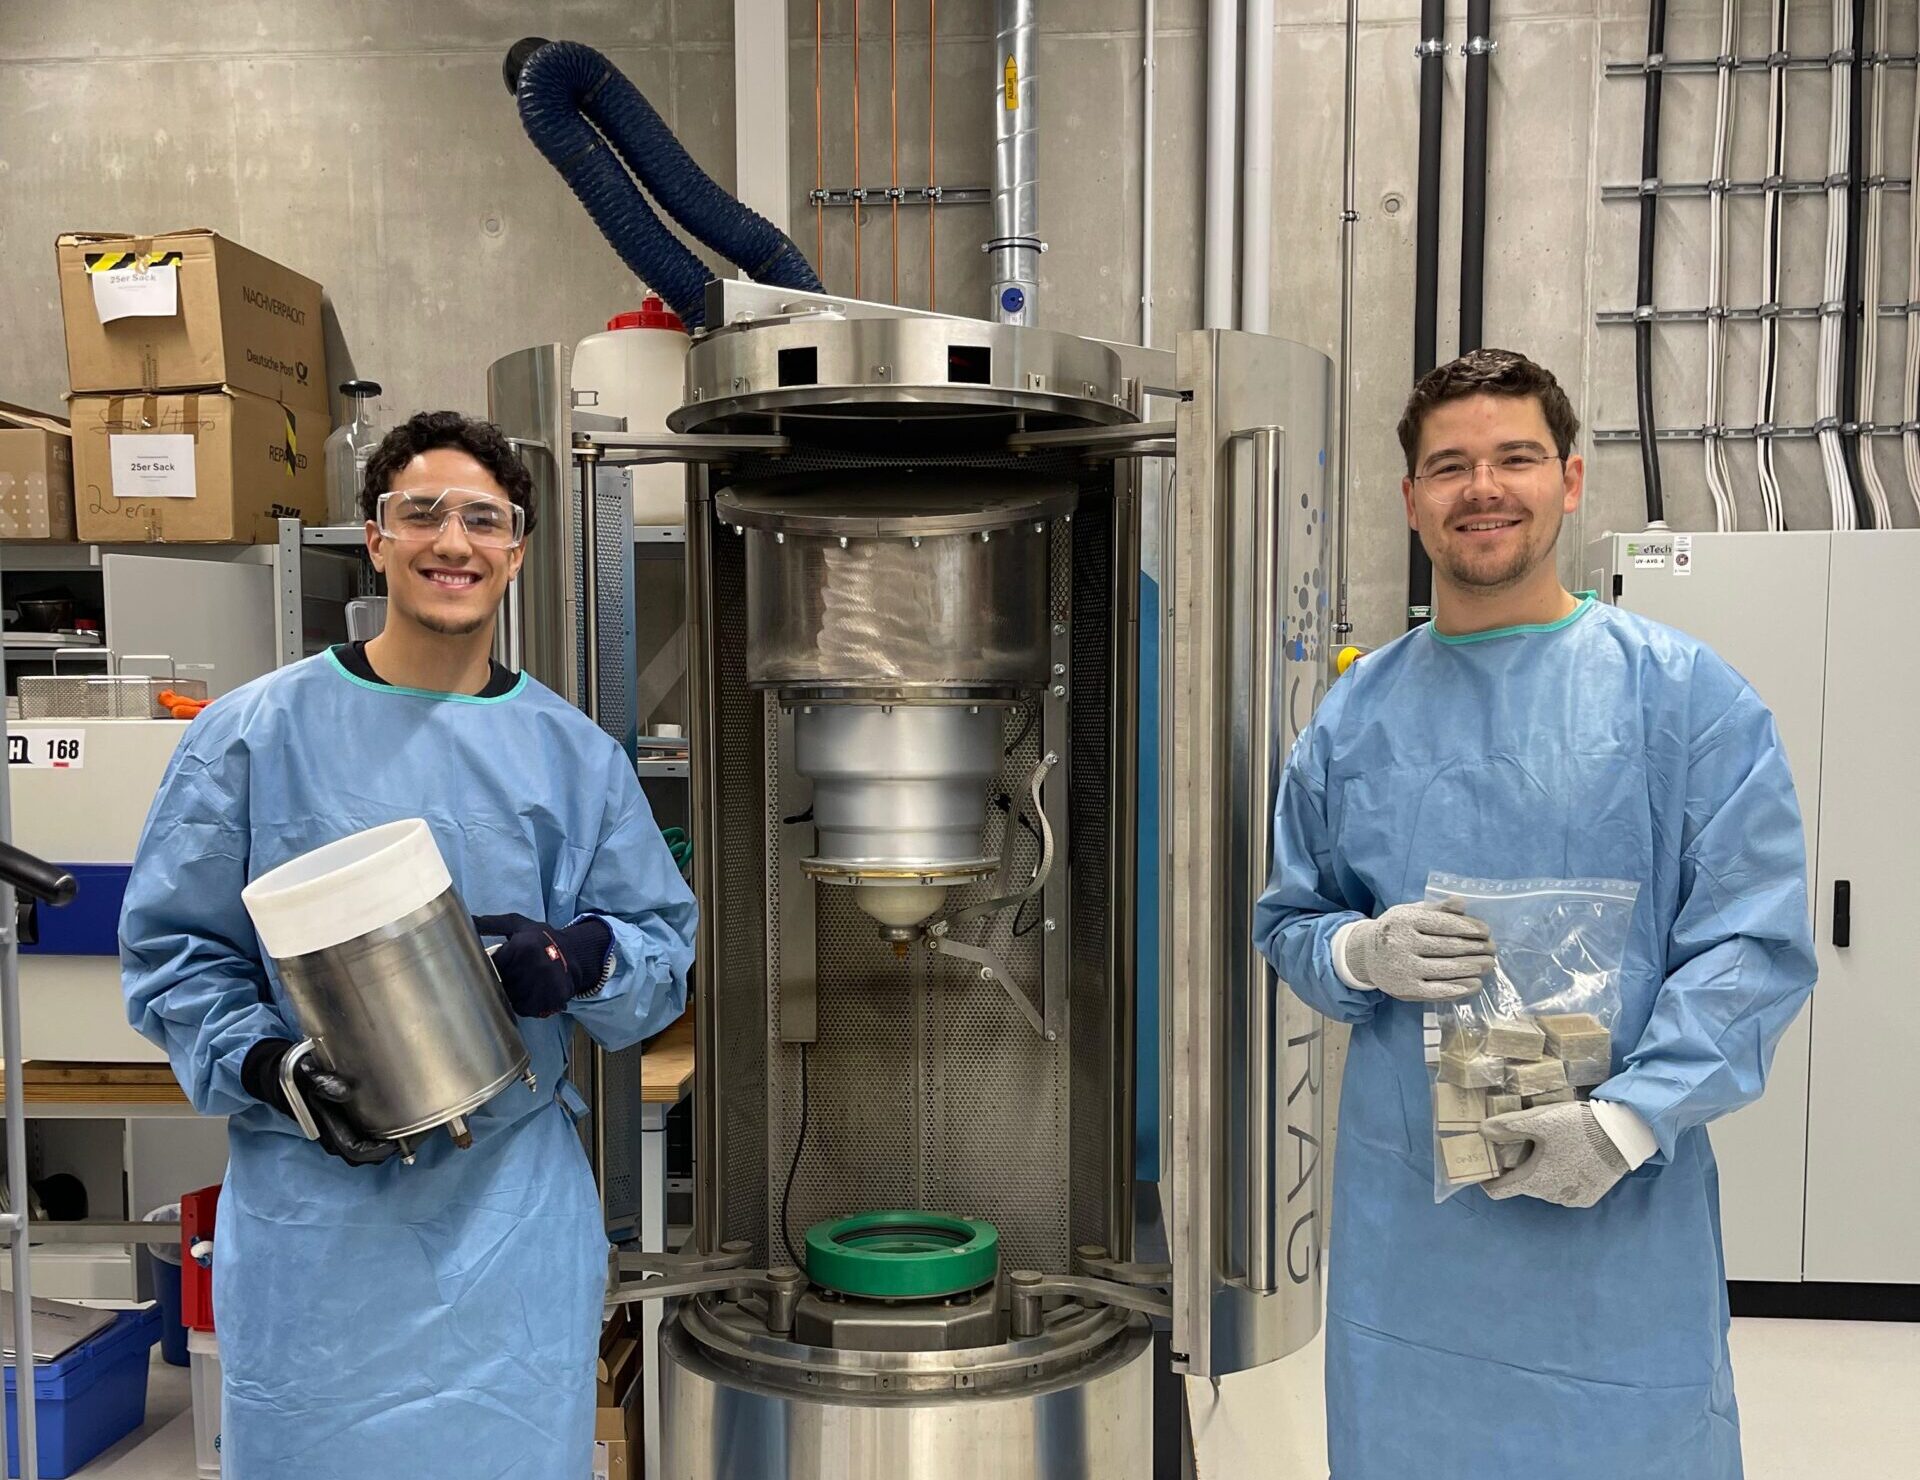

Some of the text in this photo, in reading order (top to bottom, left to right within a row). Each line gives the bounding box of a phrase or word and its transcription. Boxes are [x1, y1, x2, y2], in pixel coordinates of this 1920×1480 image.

[110, 273, 156, 284] 25er Sack
[242, 285, 306, 326] NACHVERPACKT
[246, 348, 294, 377] Deutsche Post
[130, 463, 175, 471] 25er Sack
[269, 445, 308, 470] REPAED
[1643, 544, 1672, 554] eTech
[47, 739, 79, 759] 168
